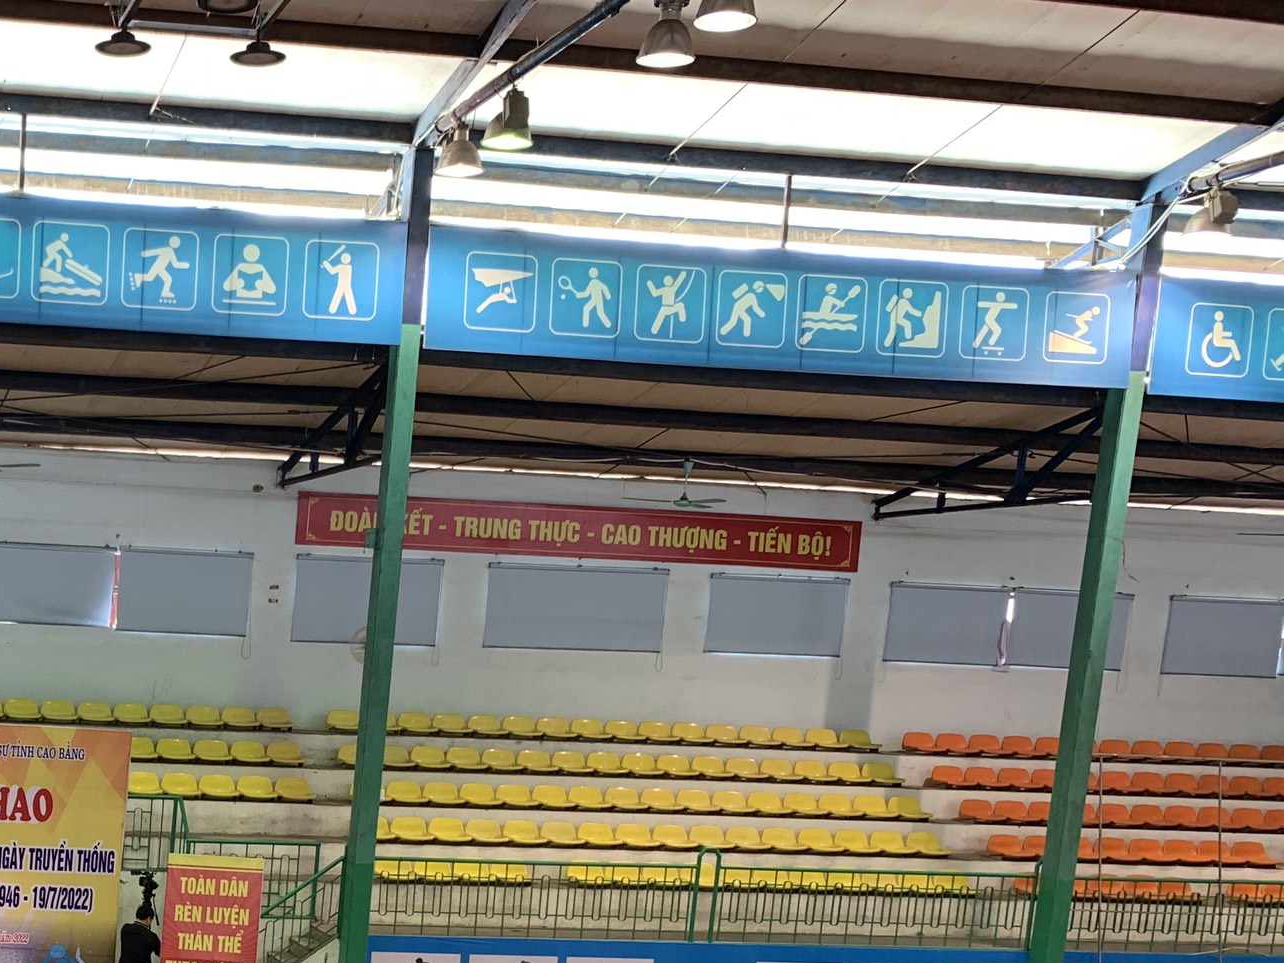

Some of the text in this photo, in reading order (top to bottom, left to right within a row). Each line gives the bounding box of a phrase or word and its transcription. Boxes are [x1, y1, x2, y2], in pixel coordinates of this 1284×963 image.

[453, 516, 833, 561] TRUNG THỰC CAO THƯỢNG TIẾN BỘ!
[10, 739, 35, 758] TỈNH
[36, 746, 56, 759] CAO
[58, 740, 85, 760] BẰNG
[28, 840, 74, 872] TRUYỀN
[77, 842, 115, 874] THỐNG
[180, 874, 249, 898] TOÀN DÂN
[32, 886, 94, 913] 19/7/2022)
[174, 902, 250, 930] RÈN LUYỆN
[13, 932, 30, 945] 2022
[177, 929, 244, 954] THÂN THỂ
